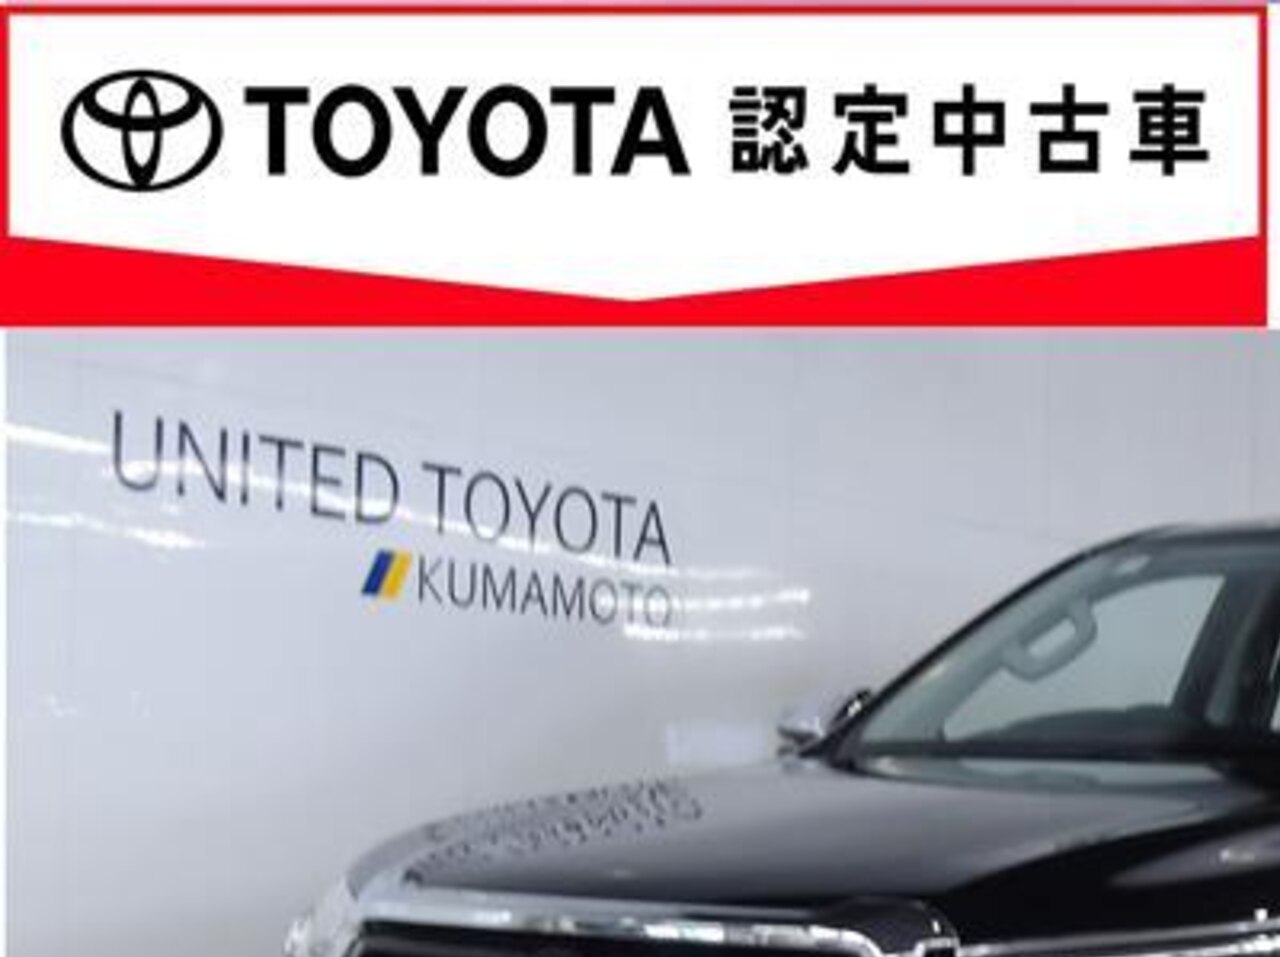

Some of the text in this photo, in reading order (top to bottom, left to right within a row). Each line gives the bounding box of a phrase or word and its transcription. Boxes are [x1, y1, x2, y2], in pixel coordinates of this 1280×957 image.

[111, 410, 673, 566] UNITED TOYOTA
[416, 554, 673, 627] KUMAMOTO
